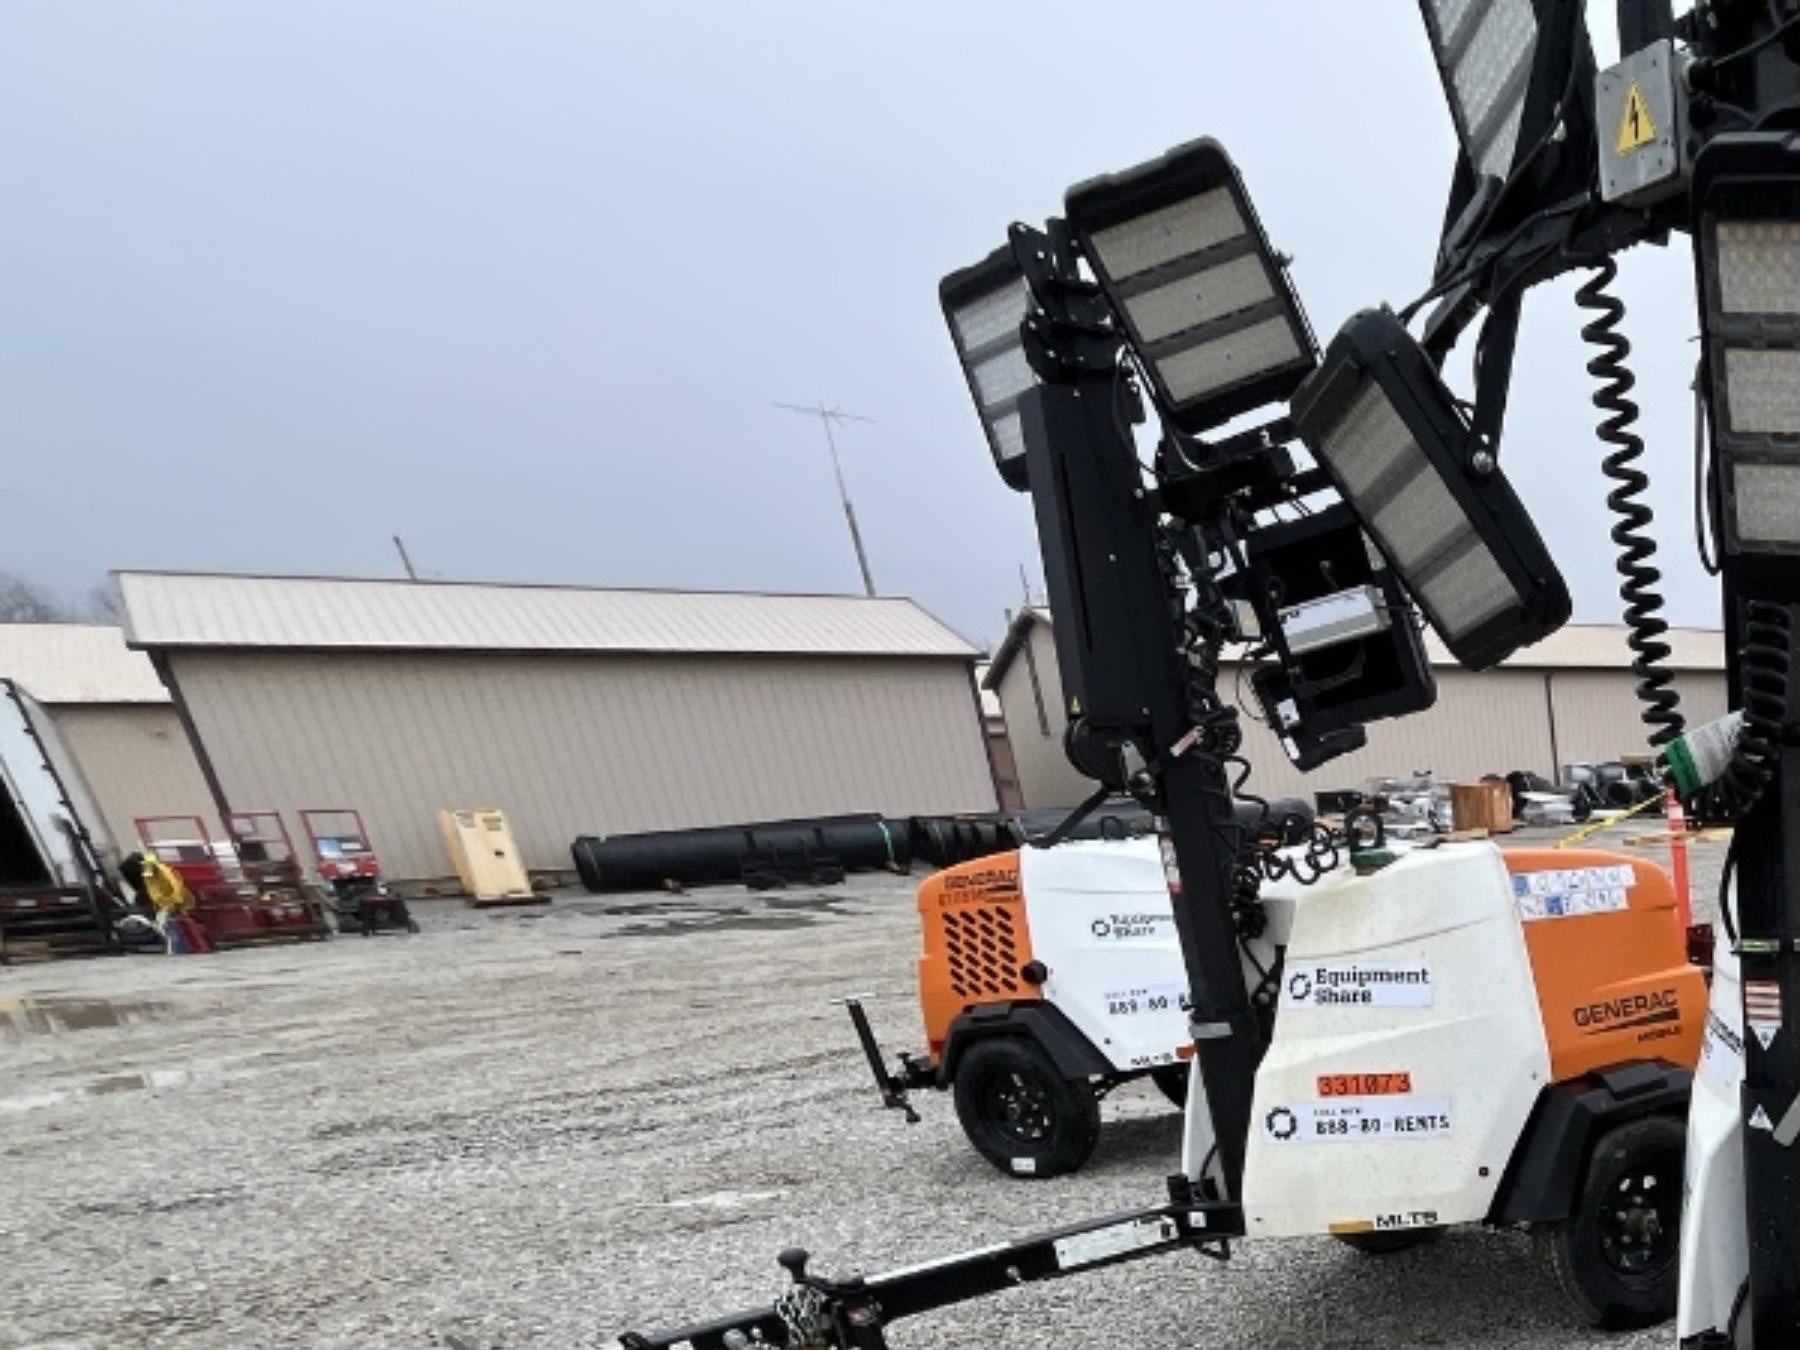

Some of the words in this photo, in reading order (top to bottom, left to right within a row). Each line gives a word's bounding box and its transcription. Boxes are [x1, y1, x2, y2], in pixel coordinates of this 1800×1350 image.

[1315, 967, 1430, 987] Equipment
[1314, 987, 1373, 1005] Share
[1573, 989, 1679, 1027] GENERAC
